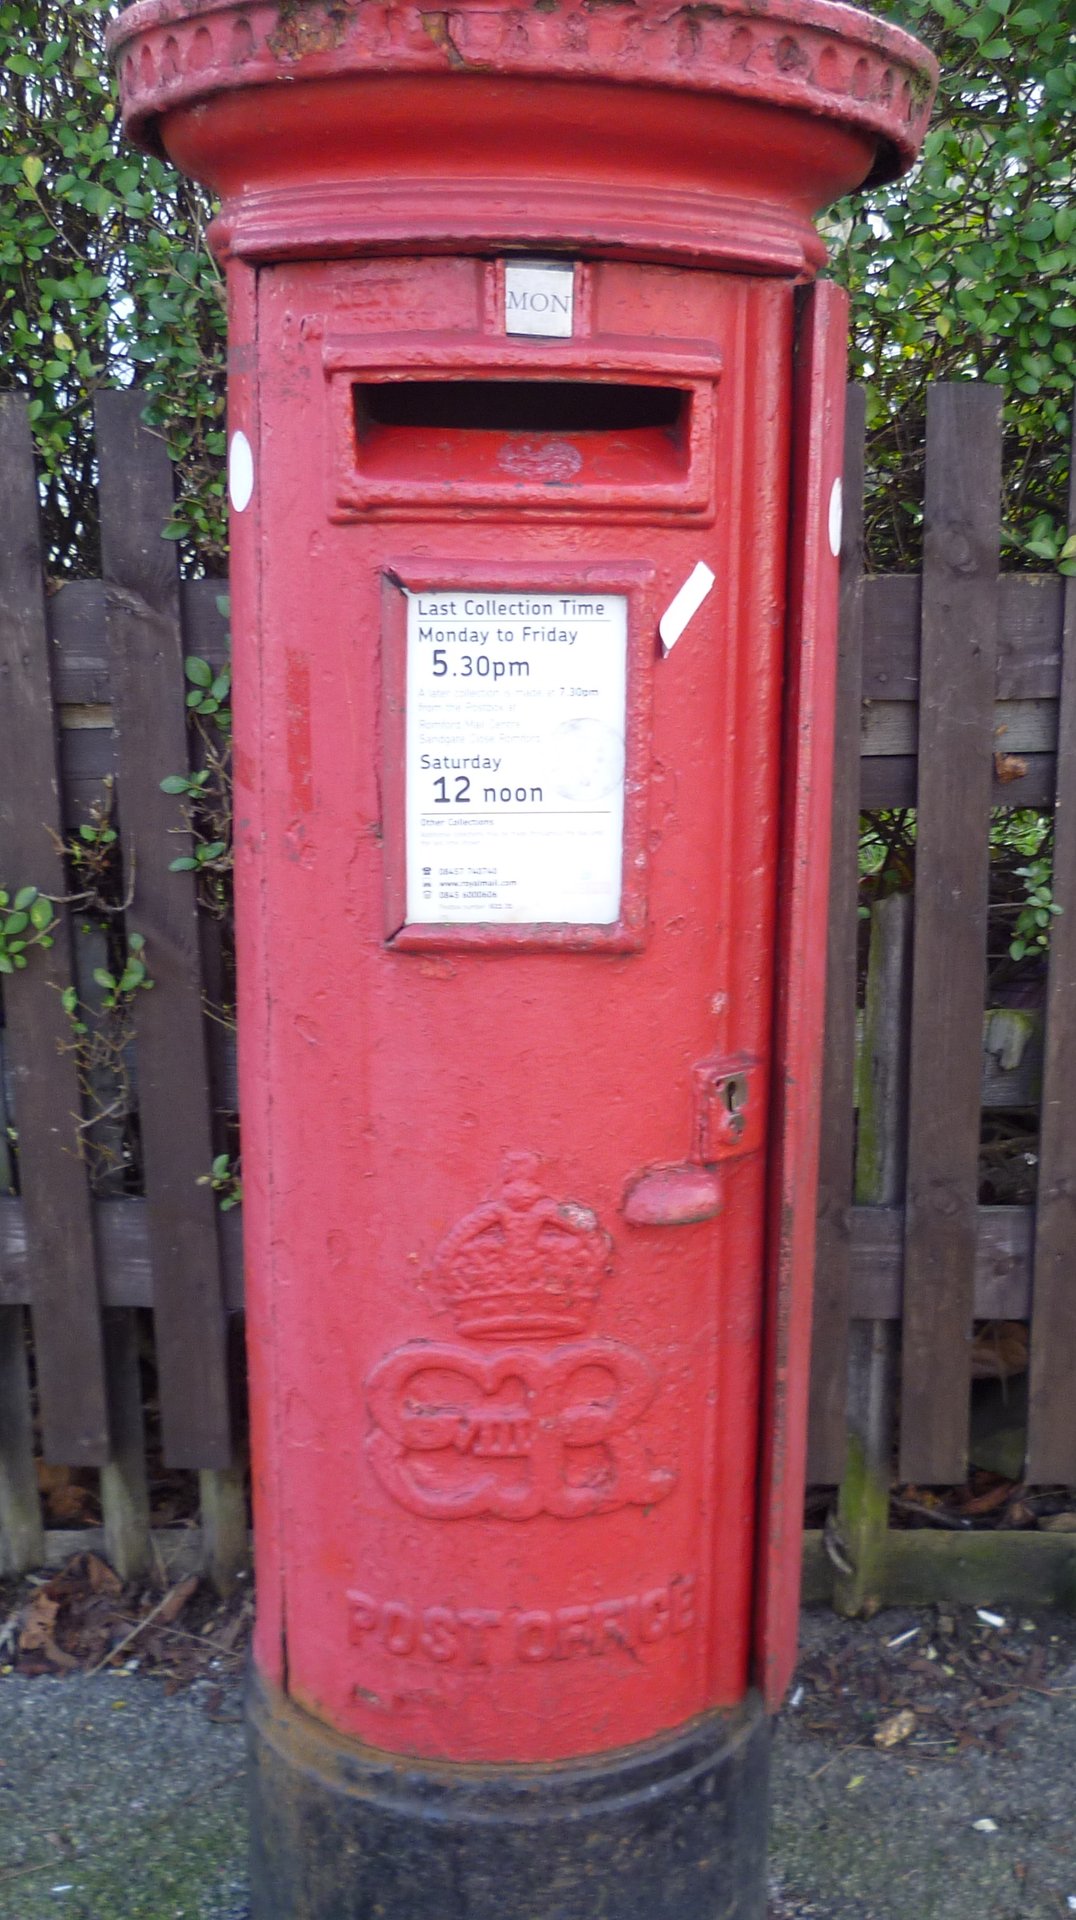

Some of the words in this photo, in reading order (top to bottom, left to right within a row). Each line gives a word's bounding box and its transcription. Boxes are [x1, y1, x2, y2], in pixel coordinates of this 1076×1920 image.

[507, 291, 571, 314] MON
[418, 600, 457, 616] Last
[464, 600, 553, 616] Collection
[559, 600, 605, 616] Time
[418, 627, 489, 645] Monday
[497, 628, 514, 642] to
[522, 627, 578, 645] Friday
[432, 649, 530, 681] 5.30pm
[559, 687, 599, 697] 7.30pm
[420, 754, 502, 771] Saturday
[433, 776, 471, 803] 12
[483, 786, 543, 802] noon
[421, 818, 444, 826] Other
[448, 818, 494, 826] Collections
[439, 879, 517, 888] www.royalmail.com
[346, 1588, 502, 1667] POST
[513, 1574, 695, 1664] OFFICE
